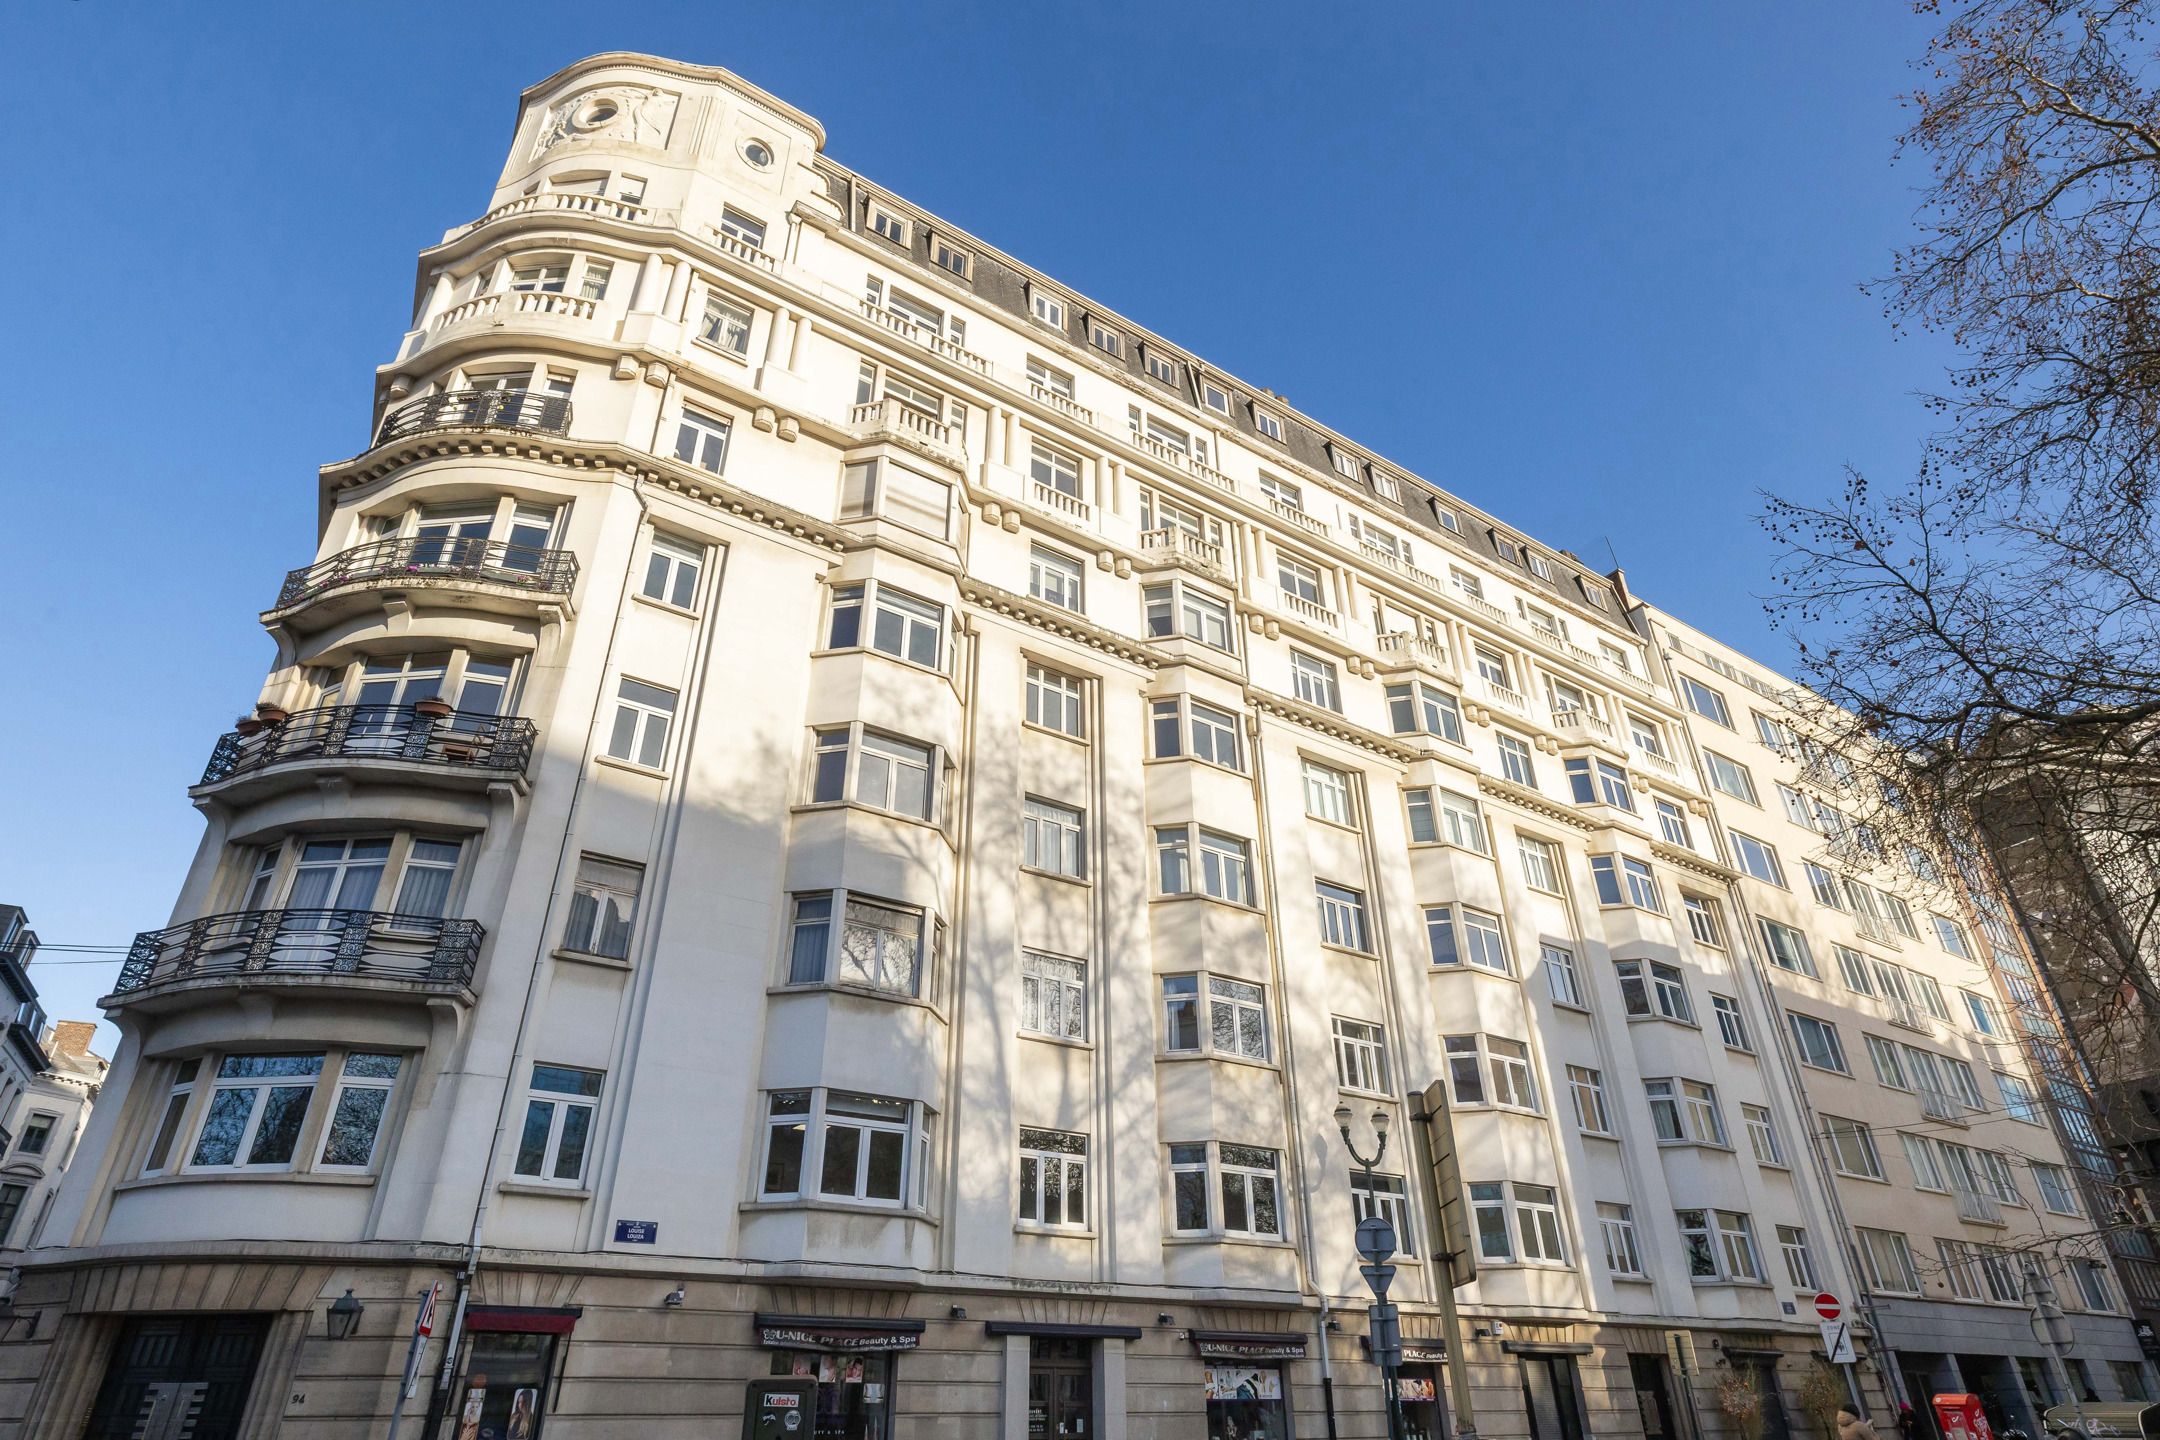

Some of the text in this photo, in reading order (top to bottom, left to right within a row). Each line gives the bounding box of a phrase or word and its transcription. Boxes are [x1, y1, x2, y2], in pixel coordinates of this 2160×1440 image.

[776, 1329, 816, 1343] U-NICE
[859, 1337, 889, 1346] Beauty
[890, 1336, 897, 1344] &
[899, 1335, 916, 1344] Spa
[1208, 1343, 1235, 1353] U-NICE
[1238, 1346, 1266, 1354] PLACE
[1291, 1346, 1304, 1354] Spa
[1403, 1349, 1426, 1359] PLACE
[292, 1393, 306, 1404] 94
